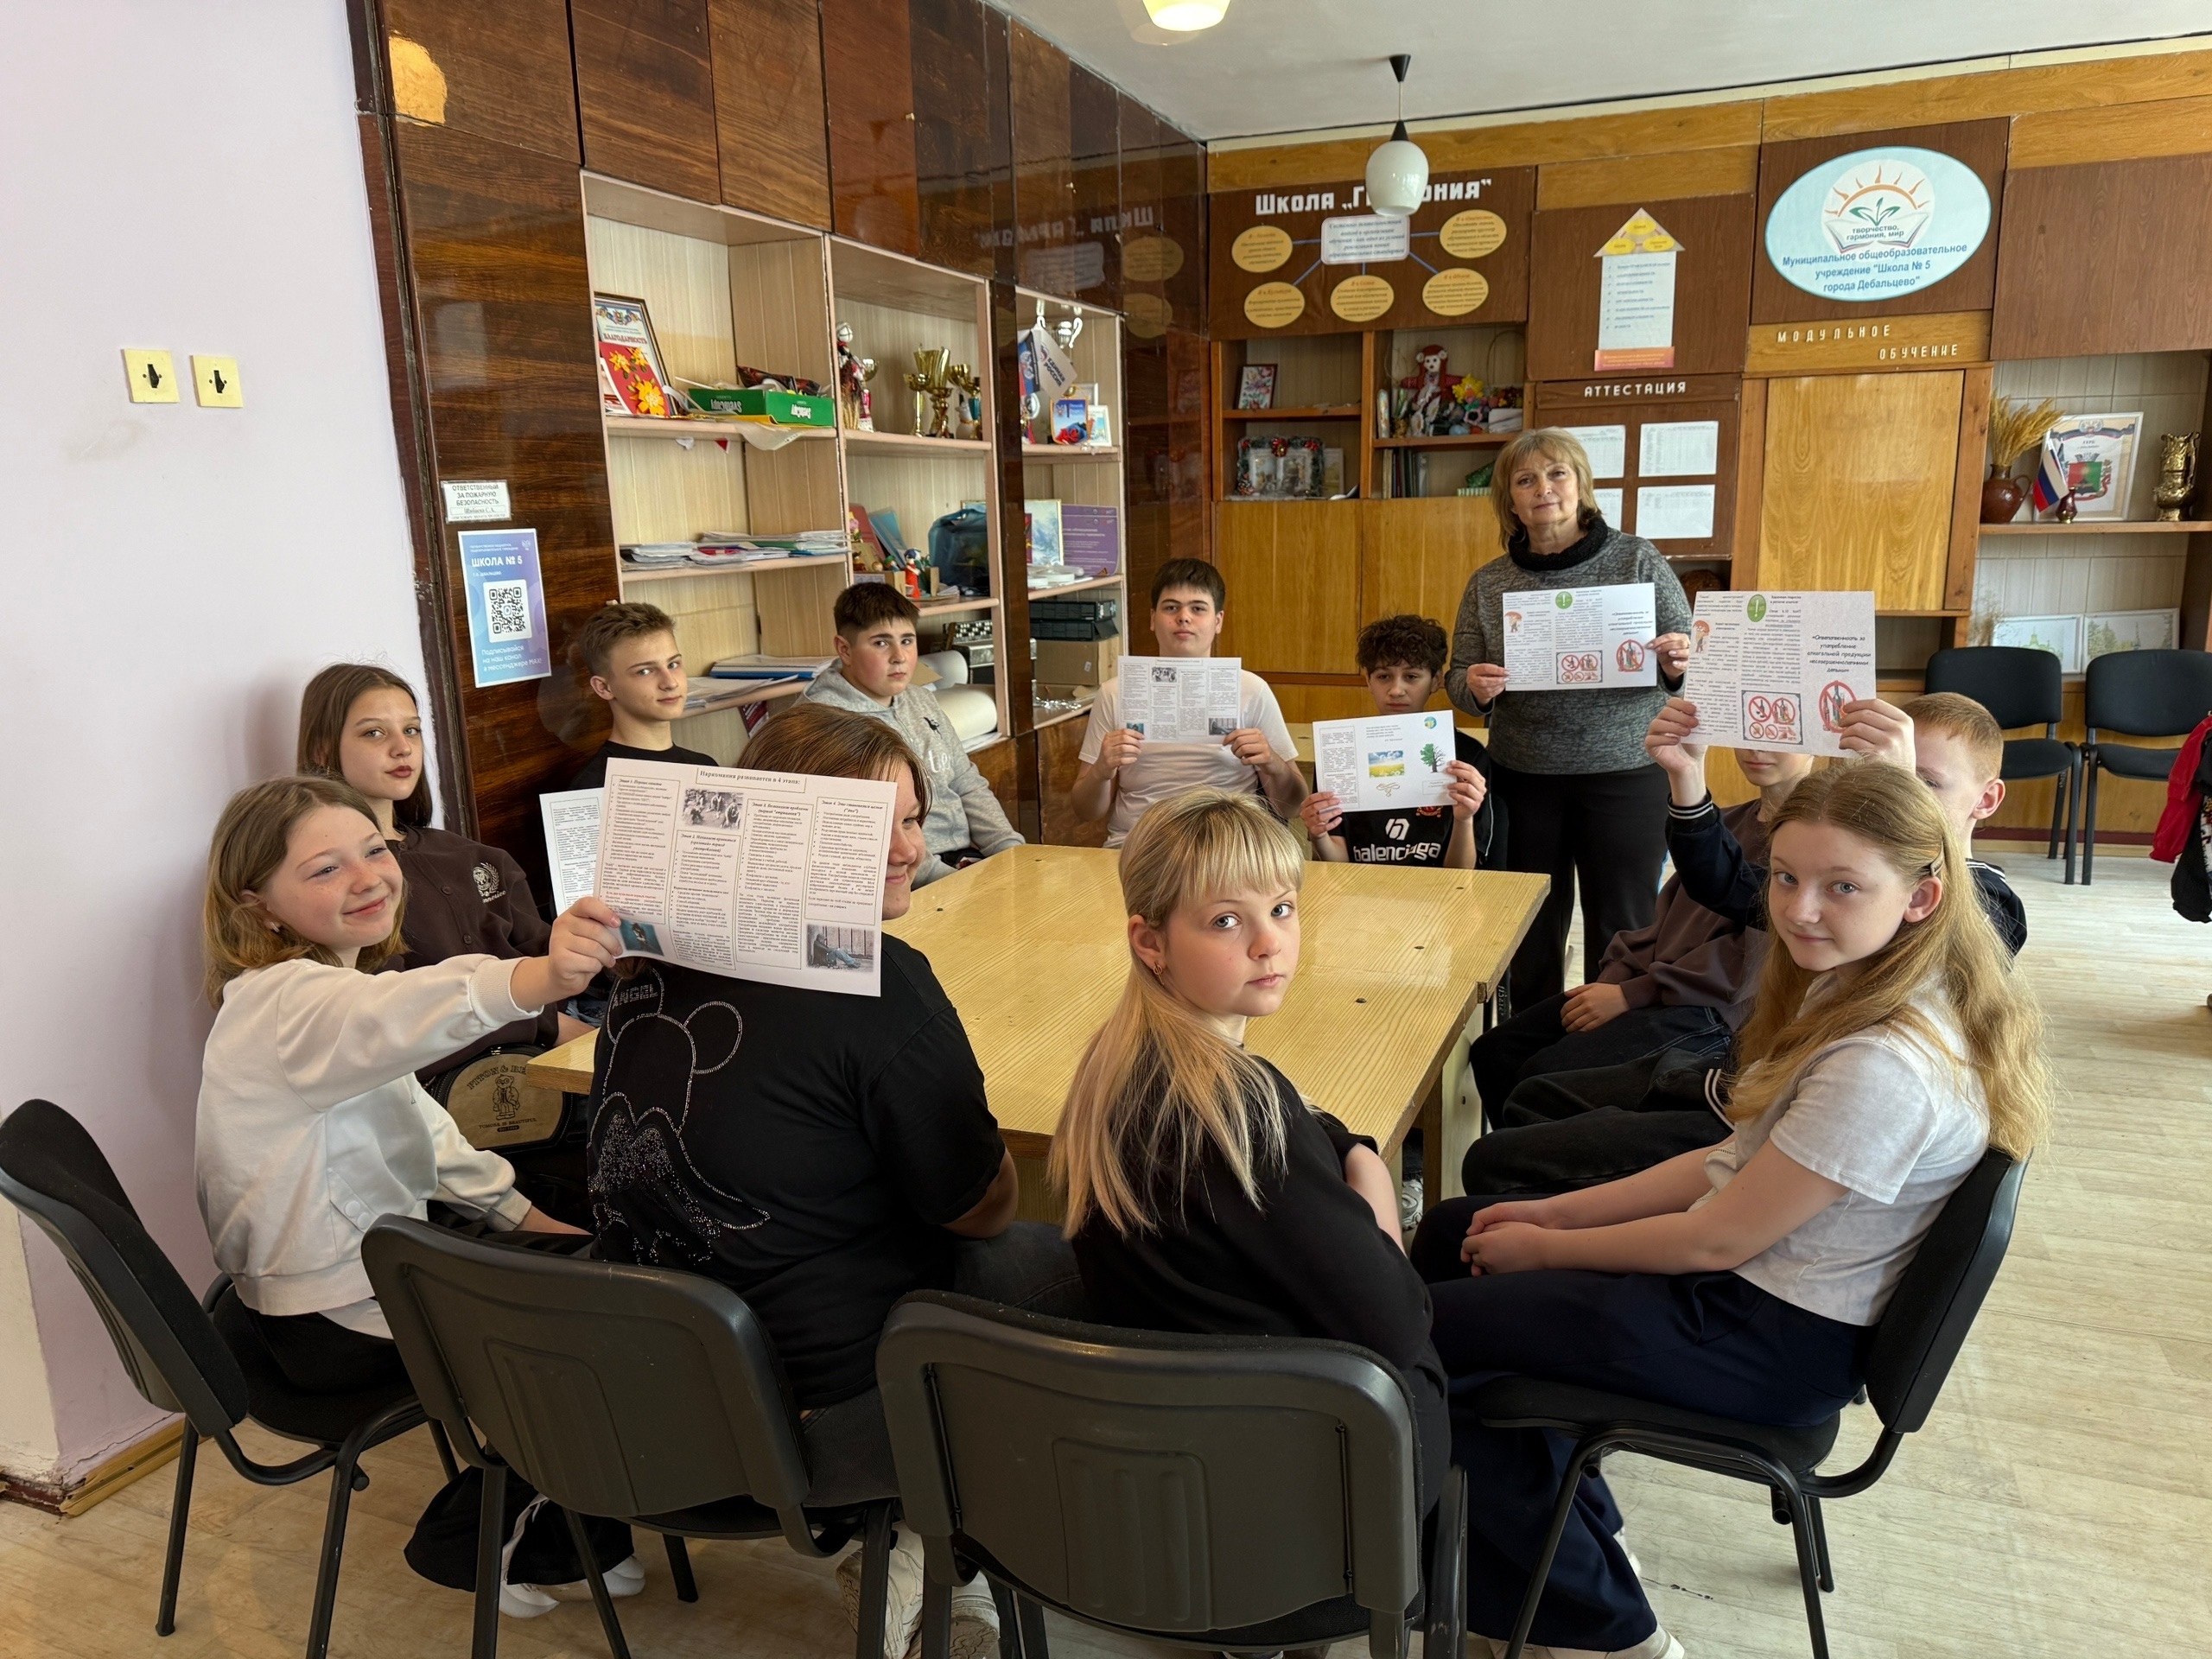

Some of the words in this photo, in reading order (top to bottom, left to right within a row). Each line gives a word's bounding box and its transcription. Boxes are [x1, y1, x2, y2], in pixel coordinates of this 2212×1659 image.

[1853, 225, 1899, 234] творчество,
[1783, 253, 1856, 268] Муниципальное
[1858, 244, 1967, 260] общеобразовательное
[1815, 266, 1871, 281] учреждение
[1873, 262, 1910, 274] "Школа
[1911, 262, 1923, 271] №
[1924, 260, 1931, 270] 5
[1823, 283, 1855, 293] города
[1857, 276, 1920, 291] Дебальцево"
[1777, 324, 1891, 343] МОДУЛЬНОЕ
[1878, 344, 1959, 360] ОБУЧЕНИЕ
[1584, 381, 1687, 398] АТТЕСТАЦИЯ
[471, 556, 504, 568] ШКОЛА
[505, 556, 516, 565] №
[517, 555, 523, 565] 5
[481, 645, 524, 656] Подписывайся
[487, 660, 529, 671] мессенджере
[613, 984, 658, 1009] ANGEL
[467, 1065, 499, 1090] PITON
